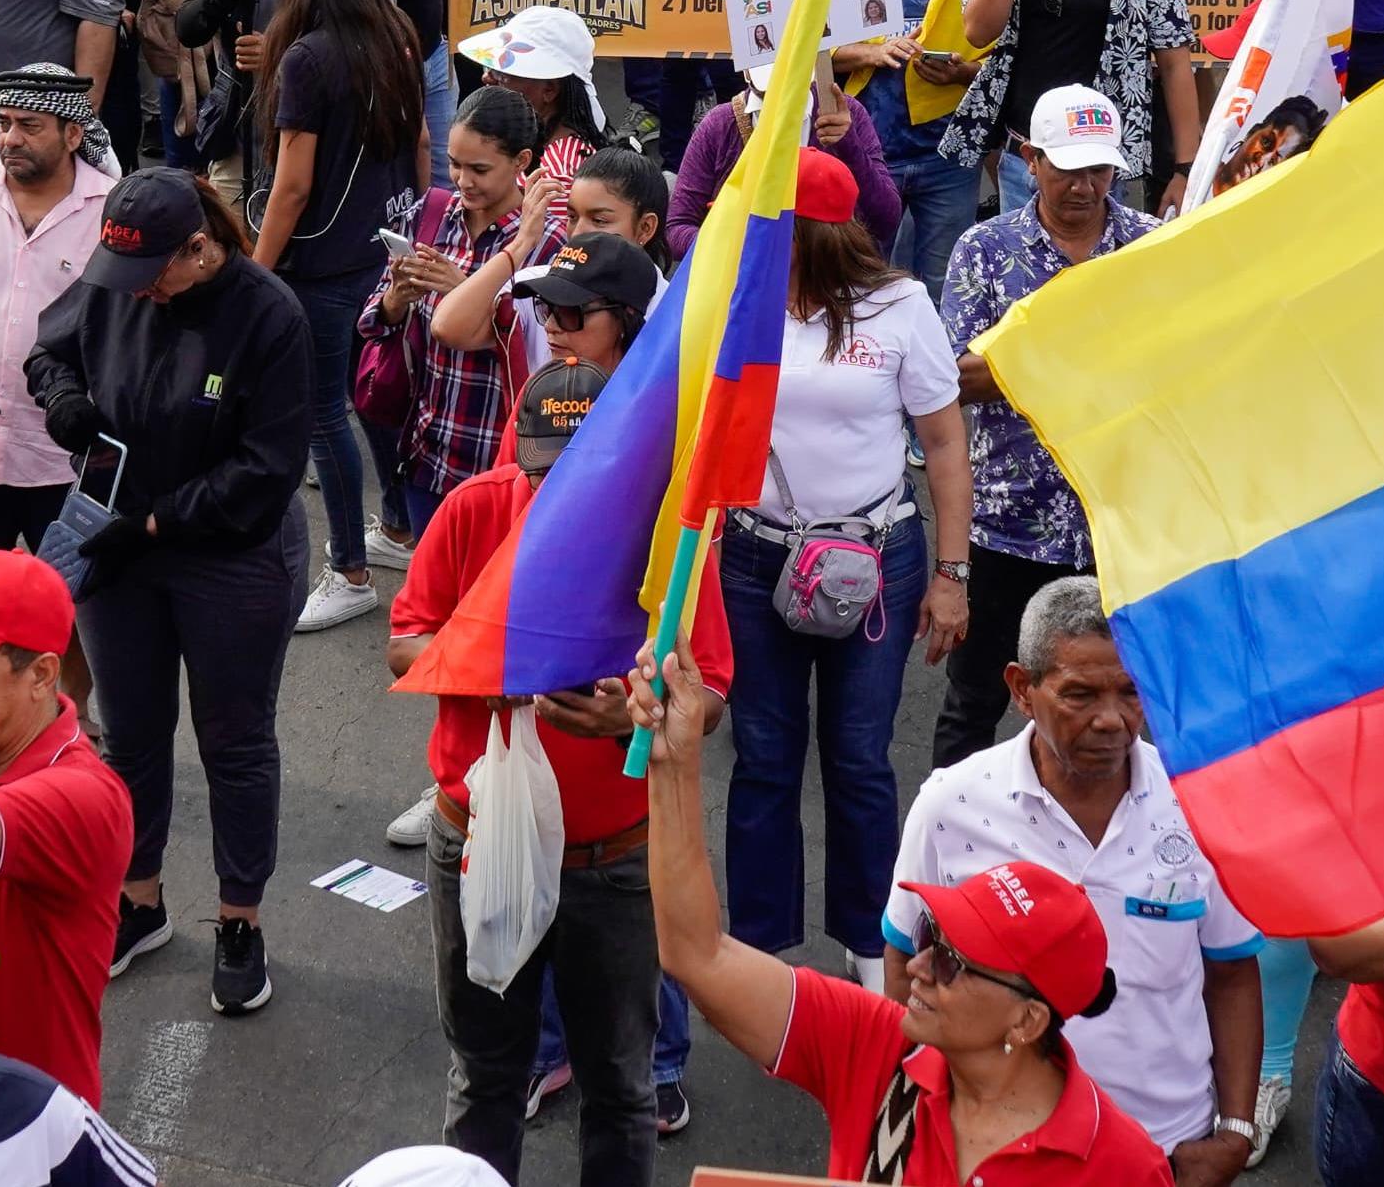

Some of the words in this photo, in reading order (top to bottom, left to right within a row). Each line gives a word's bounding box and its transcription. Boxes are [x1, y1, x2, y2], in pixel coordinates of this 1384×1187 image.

[1067, 109, 1113, 127] PETRO
[838, 354, 877, 369] ADEA
[547, 398, 593, 415] fecod
[552, 416, 568, 428] 65
